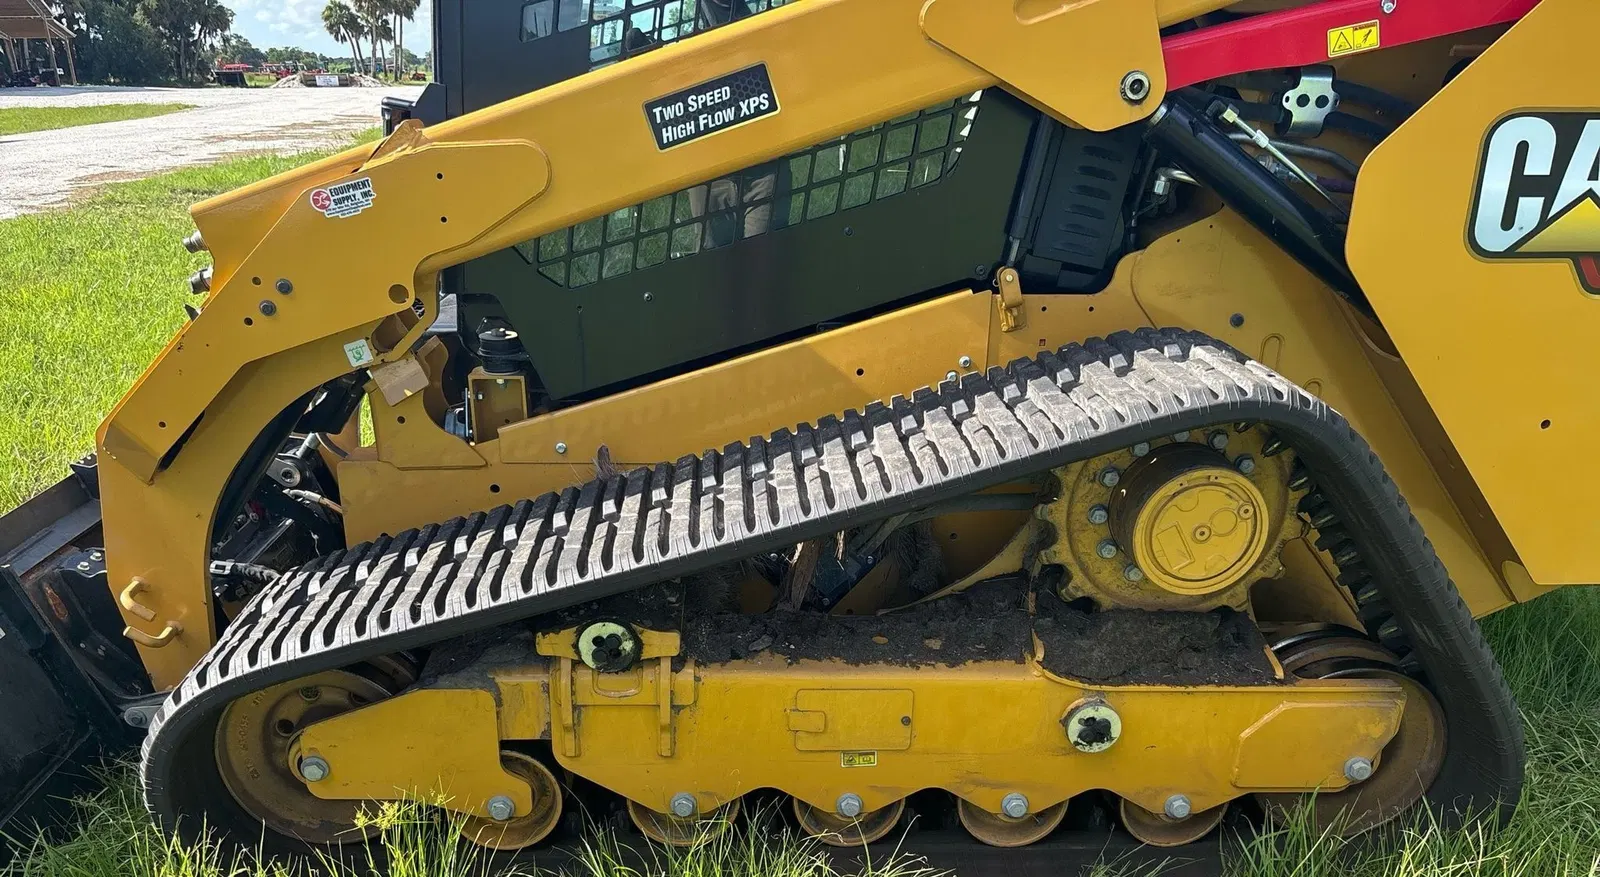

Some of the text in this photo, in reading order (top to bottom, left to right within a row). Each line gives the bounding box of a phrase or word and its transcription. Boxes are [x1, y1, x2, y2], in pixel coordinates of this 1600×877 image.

[652, 86, 731, 124] TWO SPEED
[661, 93, 769, 144] HIGH FLOW XPS
[329, 179, 371, 197] EQUIPMENT
[333, 193, 360, 206] SUPPLY,
[361, 190, 375, 199] INC.
